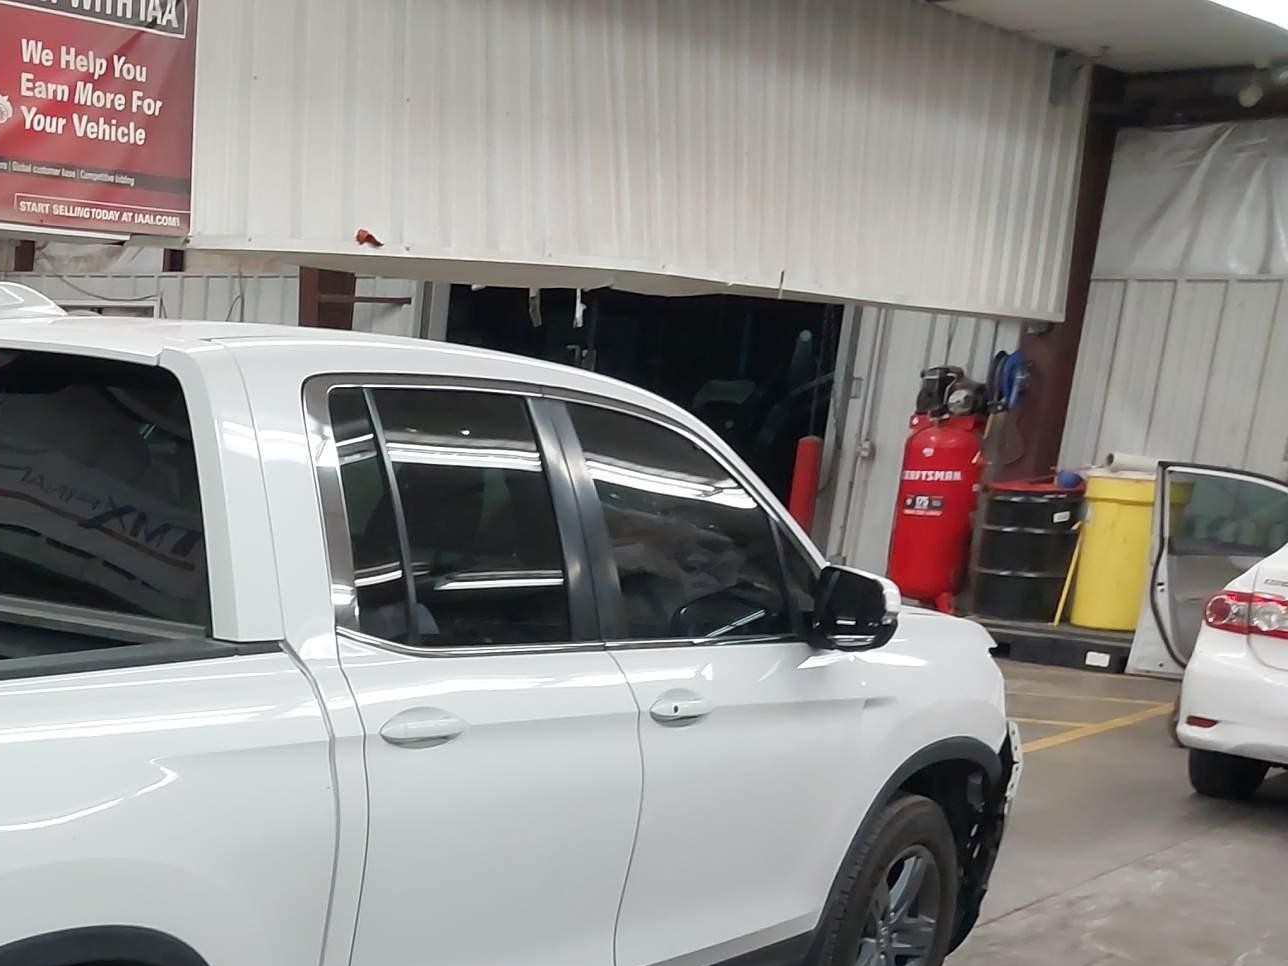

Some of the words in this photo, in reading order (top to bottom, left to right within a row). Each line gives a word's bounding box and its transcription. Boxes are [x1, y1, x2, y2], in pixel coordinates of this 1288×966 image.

[71, 0, 133, 19] TH
[139, 0, 179, 28] IAA
[21, 38, 54, 67] We
[60, 45, 108, 80] Help
[112, 54, 147, 82] You
[20, 72, 70, 102] Earn
[73, 80, 126, 111] More
[131, 90, 163, 116] For
[20, 105, 66, 134] Your
[72, 113, 146, 145] Vehicle
[19, 200, 51, 215] START
[52, 204, 90, 219] SELLING
[90, 206, 121, 222] TODAY
[121, 211, 134, 223] AT
